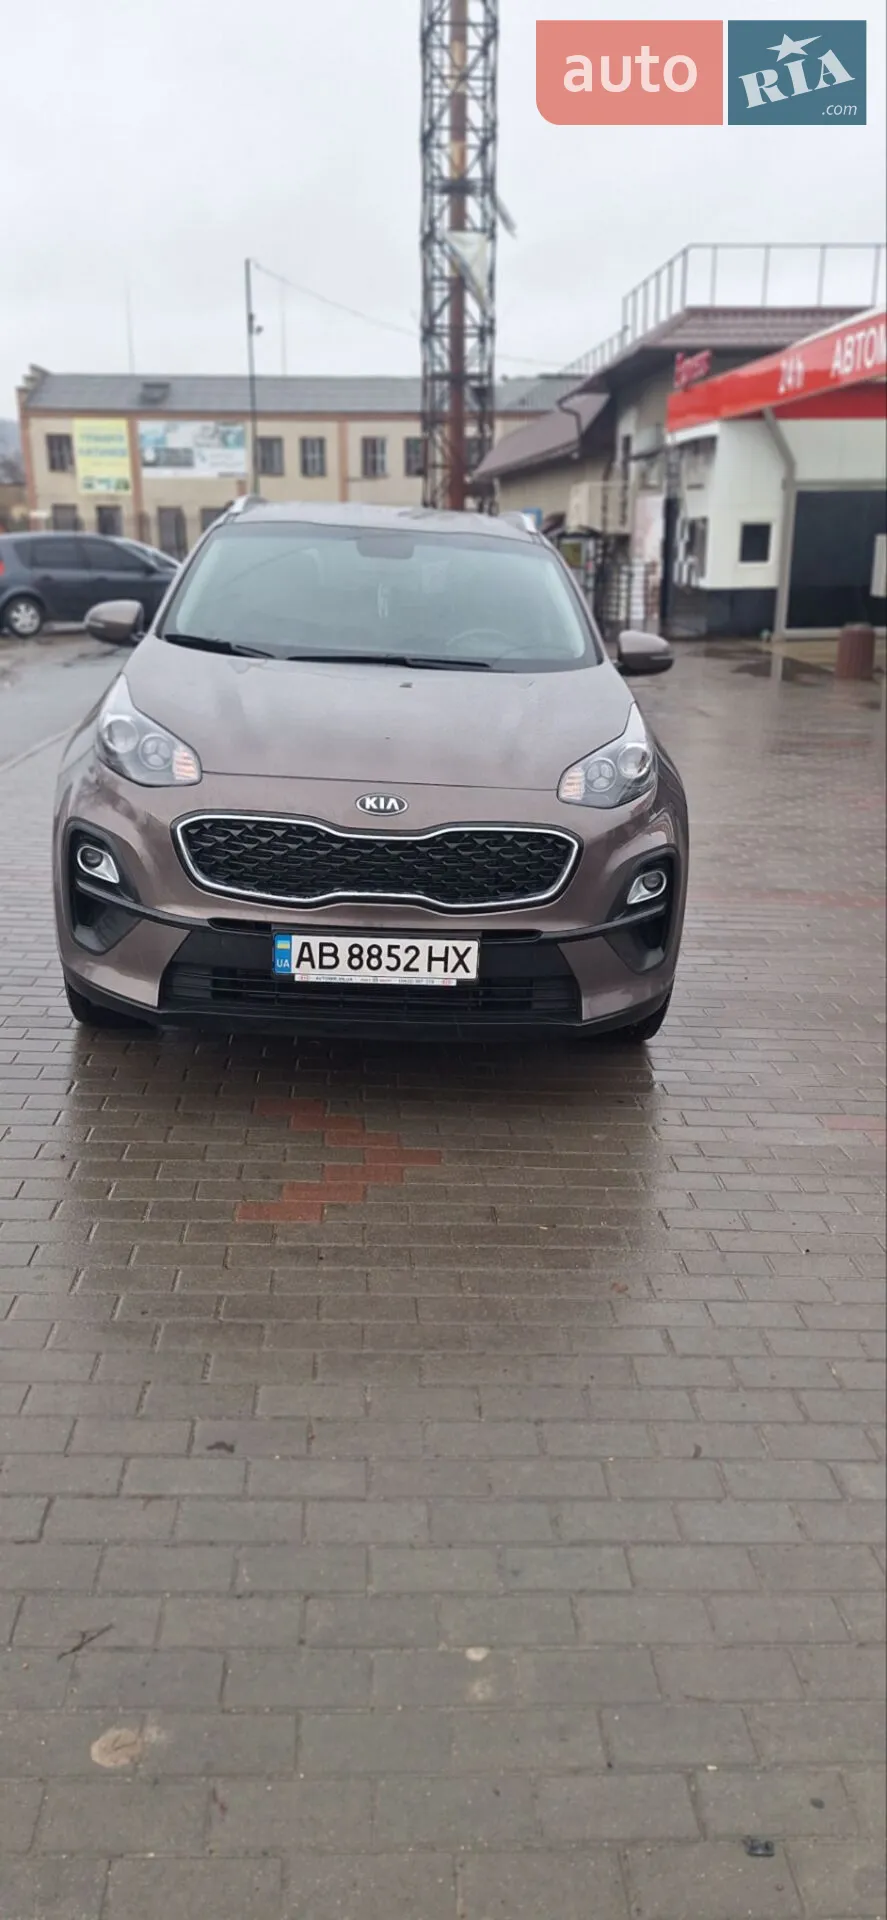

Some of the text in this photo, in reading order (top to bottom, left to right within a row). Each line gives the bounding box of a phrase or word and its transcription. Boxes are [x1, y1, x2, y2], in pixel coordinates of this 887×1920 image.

[365, 796, 400, 811] KIA
[276, 958, 290, 969] UA
[295, 941, 472, 974] AB 8852 HX
